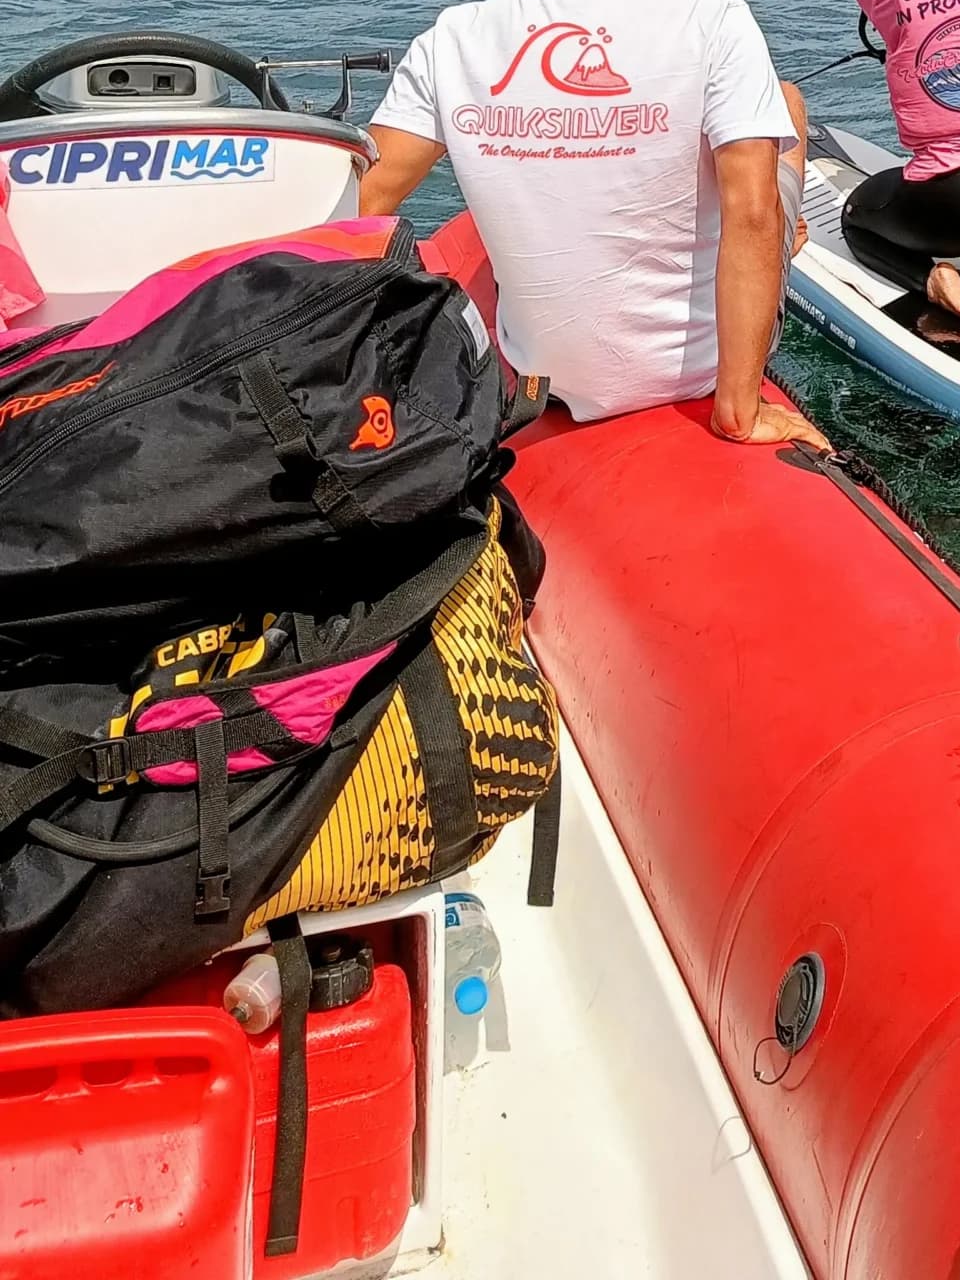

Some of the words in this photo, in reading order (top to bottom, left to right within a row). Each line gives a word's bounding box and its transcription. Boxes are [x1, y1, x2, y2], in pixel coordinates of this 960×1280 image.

[896, 7, 912, 26] IN
[451, 102, 670, 140] QUIKSILVER
[478, 143, 499, 157] The
[500, 144, 552, 161] Original
[552, 146, 623, 159] Boardshort
